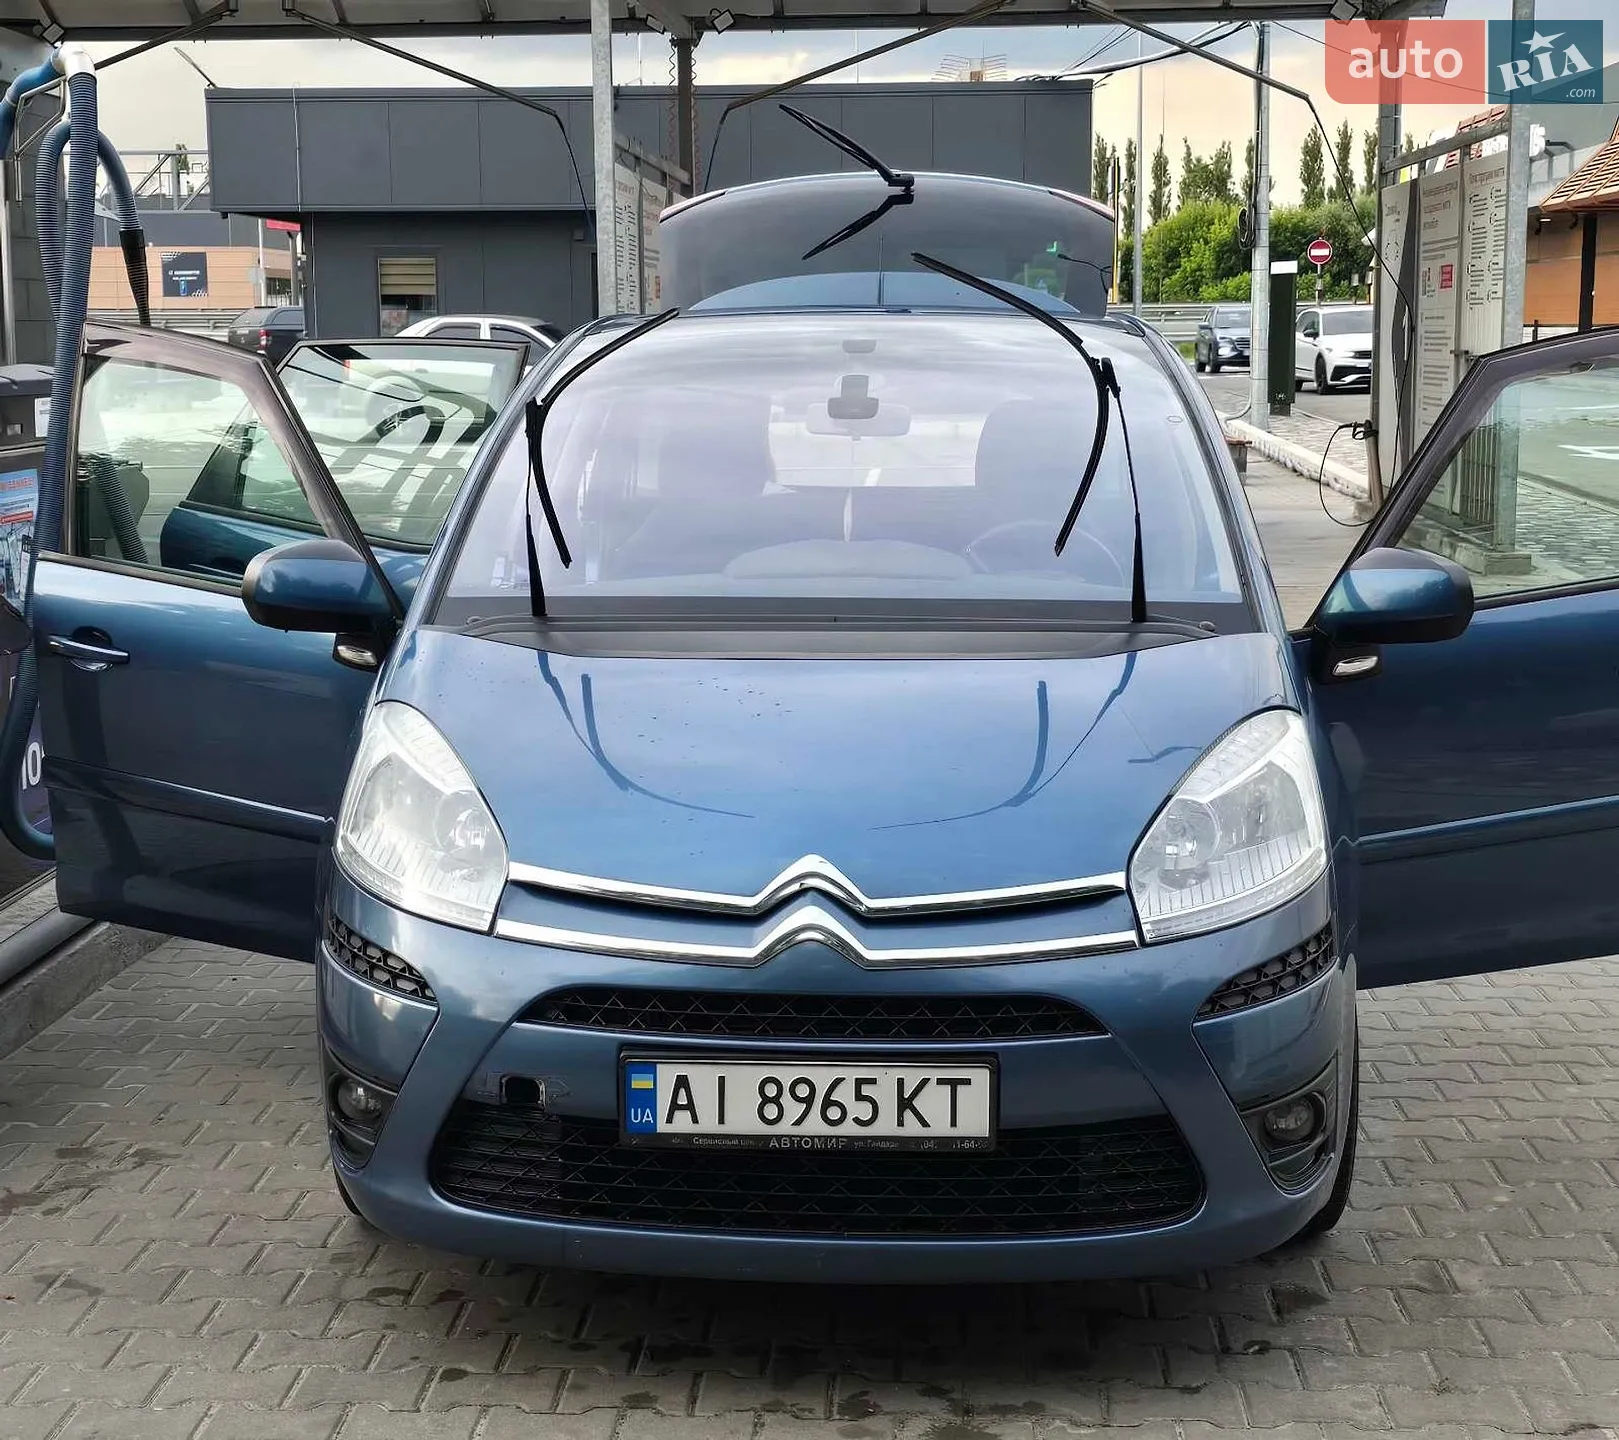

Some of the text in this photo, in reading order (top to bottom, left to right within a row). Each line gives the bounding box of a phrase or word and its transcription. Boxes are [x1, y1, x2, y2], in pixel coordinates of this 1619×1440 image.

[631, 1108, 654, 1124] UA
[665, 1074, 972, 1128] AI 8965 KT
